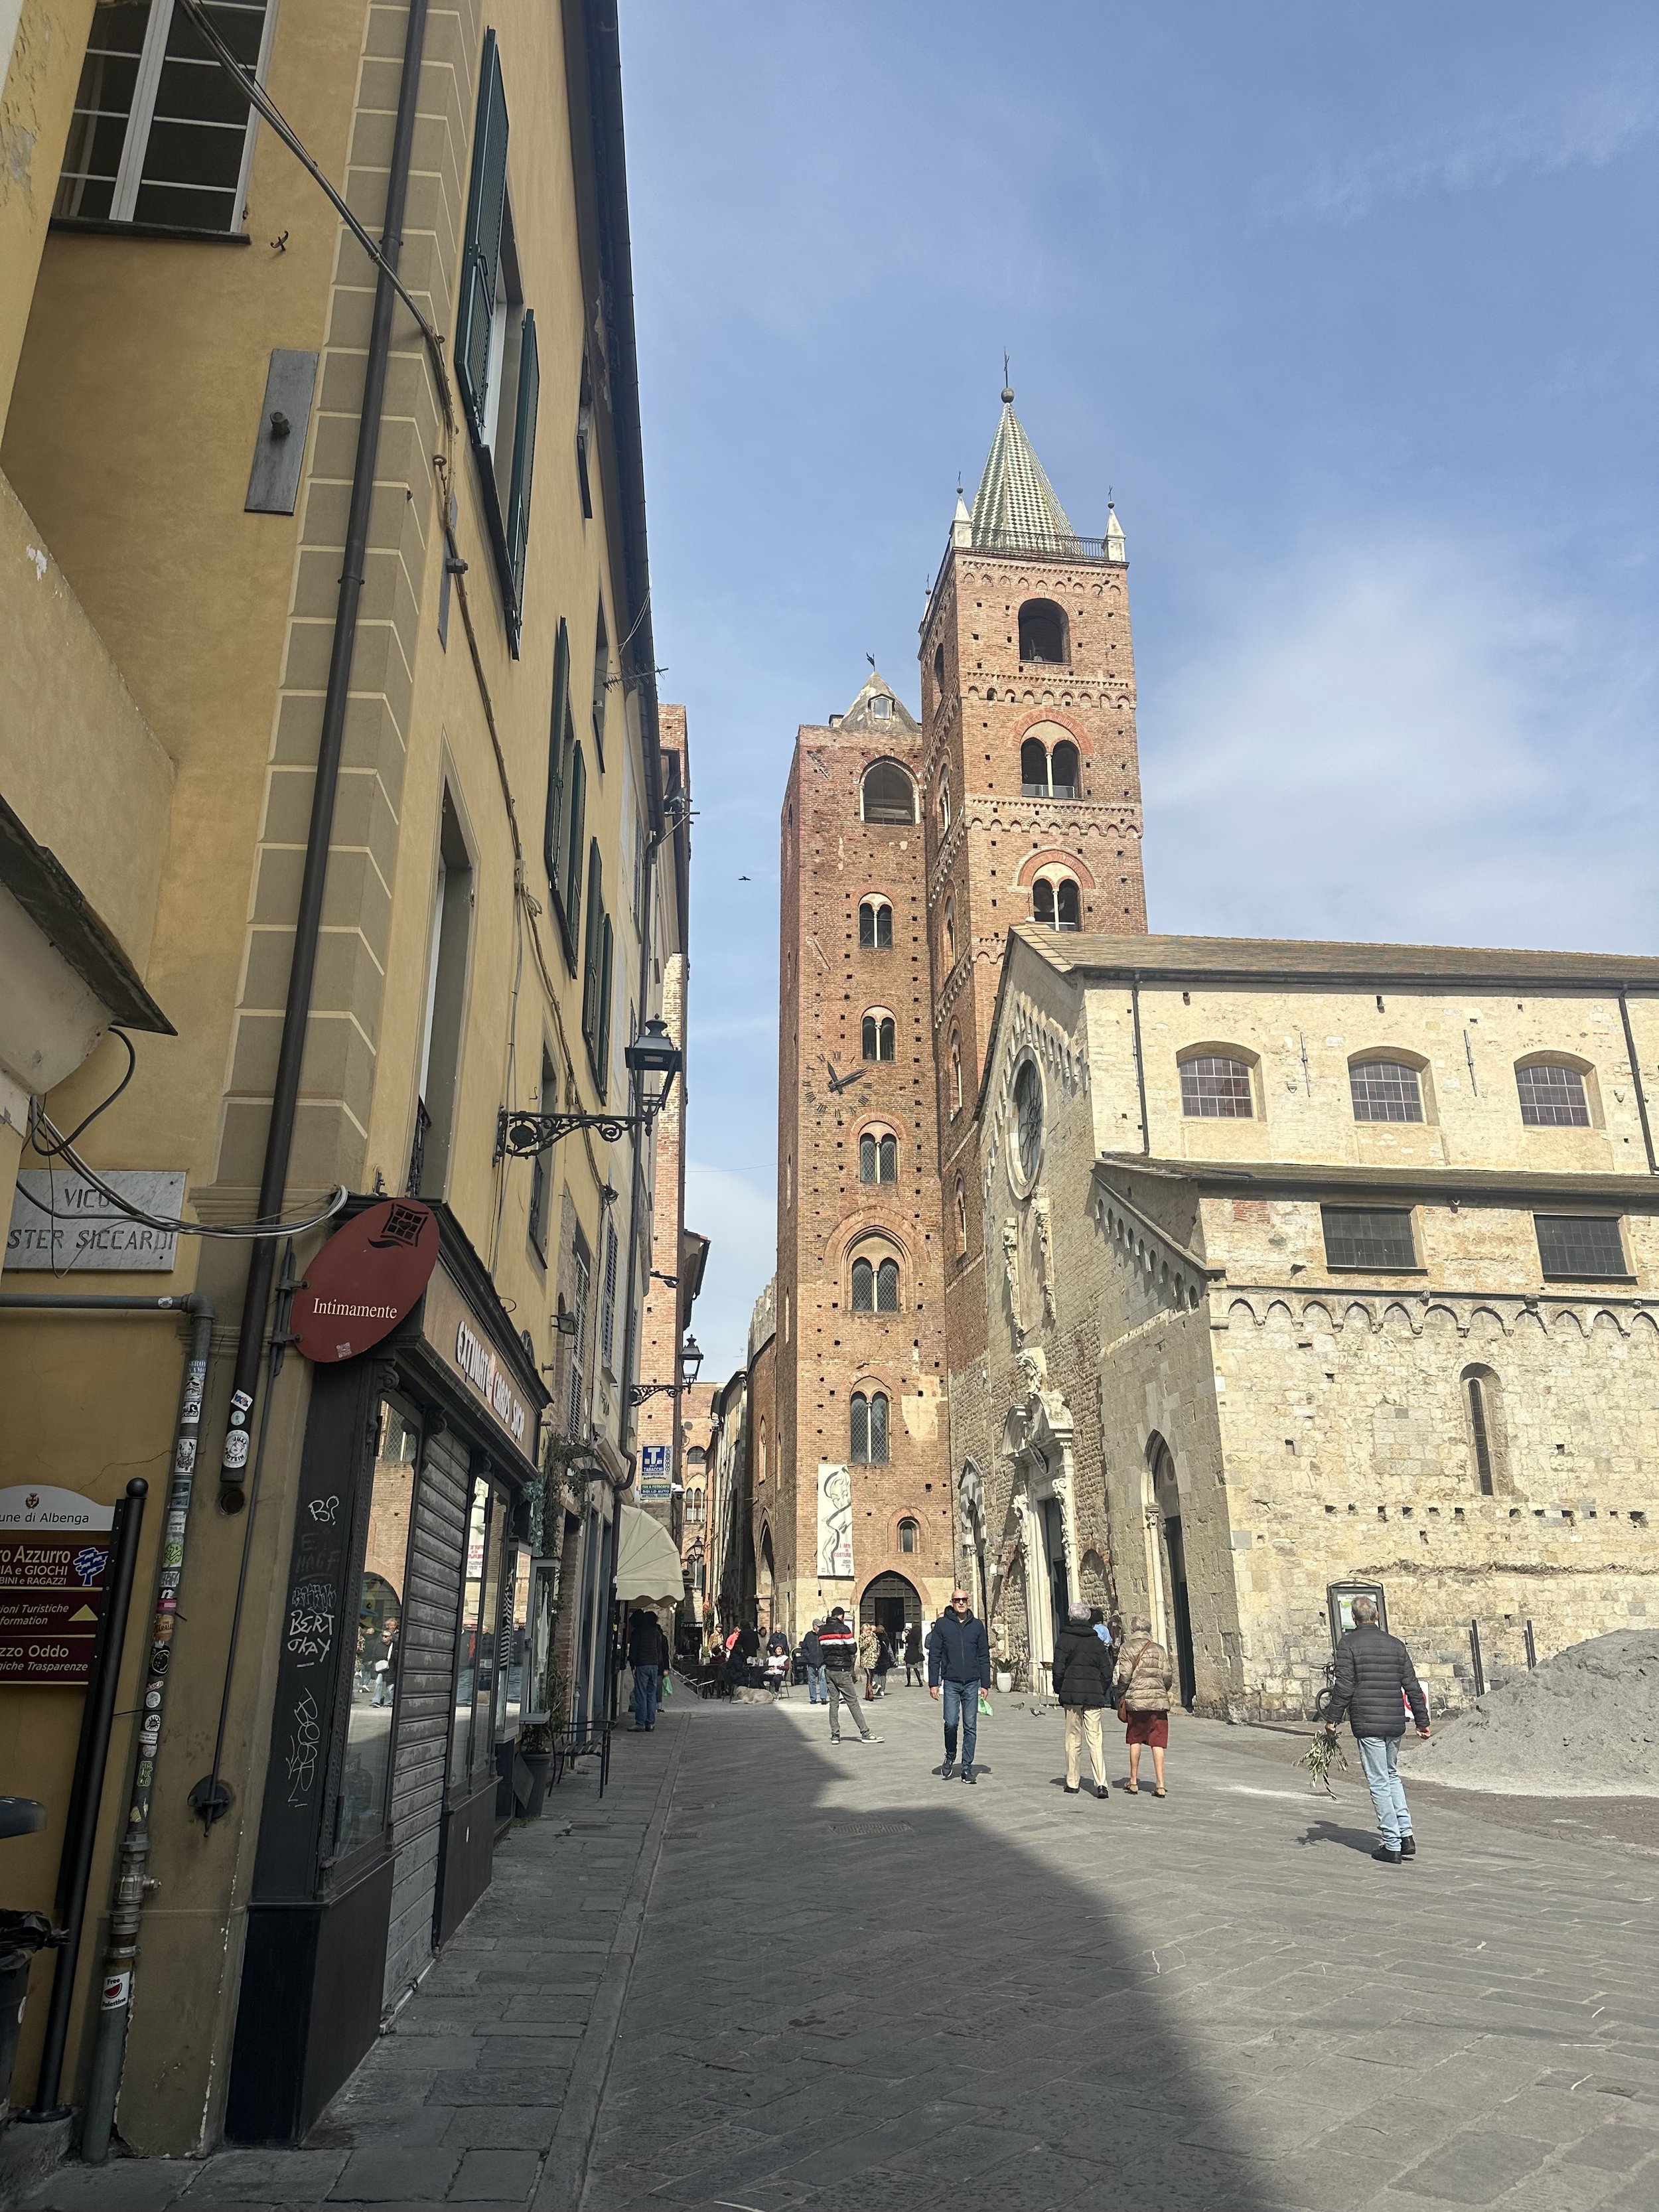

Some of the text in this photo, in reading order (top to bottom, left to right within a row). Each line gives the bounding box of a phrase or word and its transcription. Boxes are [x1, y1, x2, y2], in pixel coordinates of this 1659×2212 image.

[76, 1230, 173, 1250] SICCARDI
[313, 1297, 397, 1319] Intimamente
[25, 1512, 36, 1522] di
[40, 1512, 89, 1524] Albenga
[13, 1545, 71, 1563] Azzurro
[25, 1565, 68, 1576] GIOCHI
[0, 1603, 69, 1613] ioni Turistiche
[29, 1645, 69, 1657] Oddo
[27, 1662, 88, 1672] Trasparenze
[102, 1997, 126, 2008] Palestine
